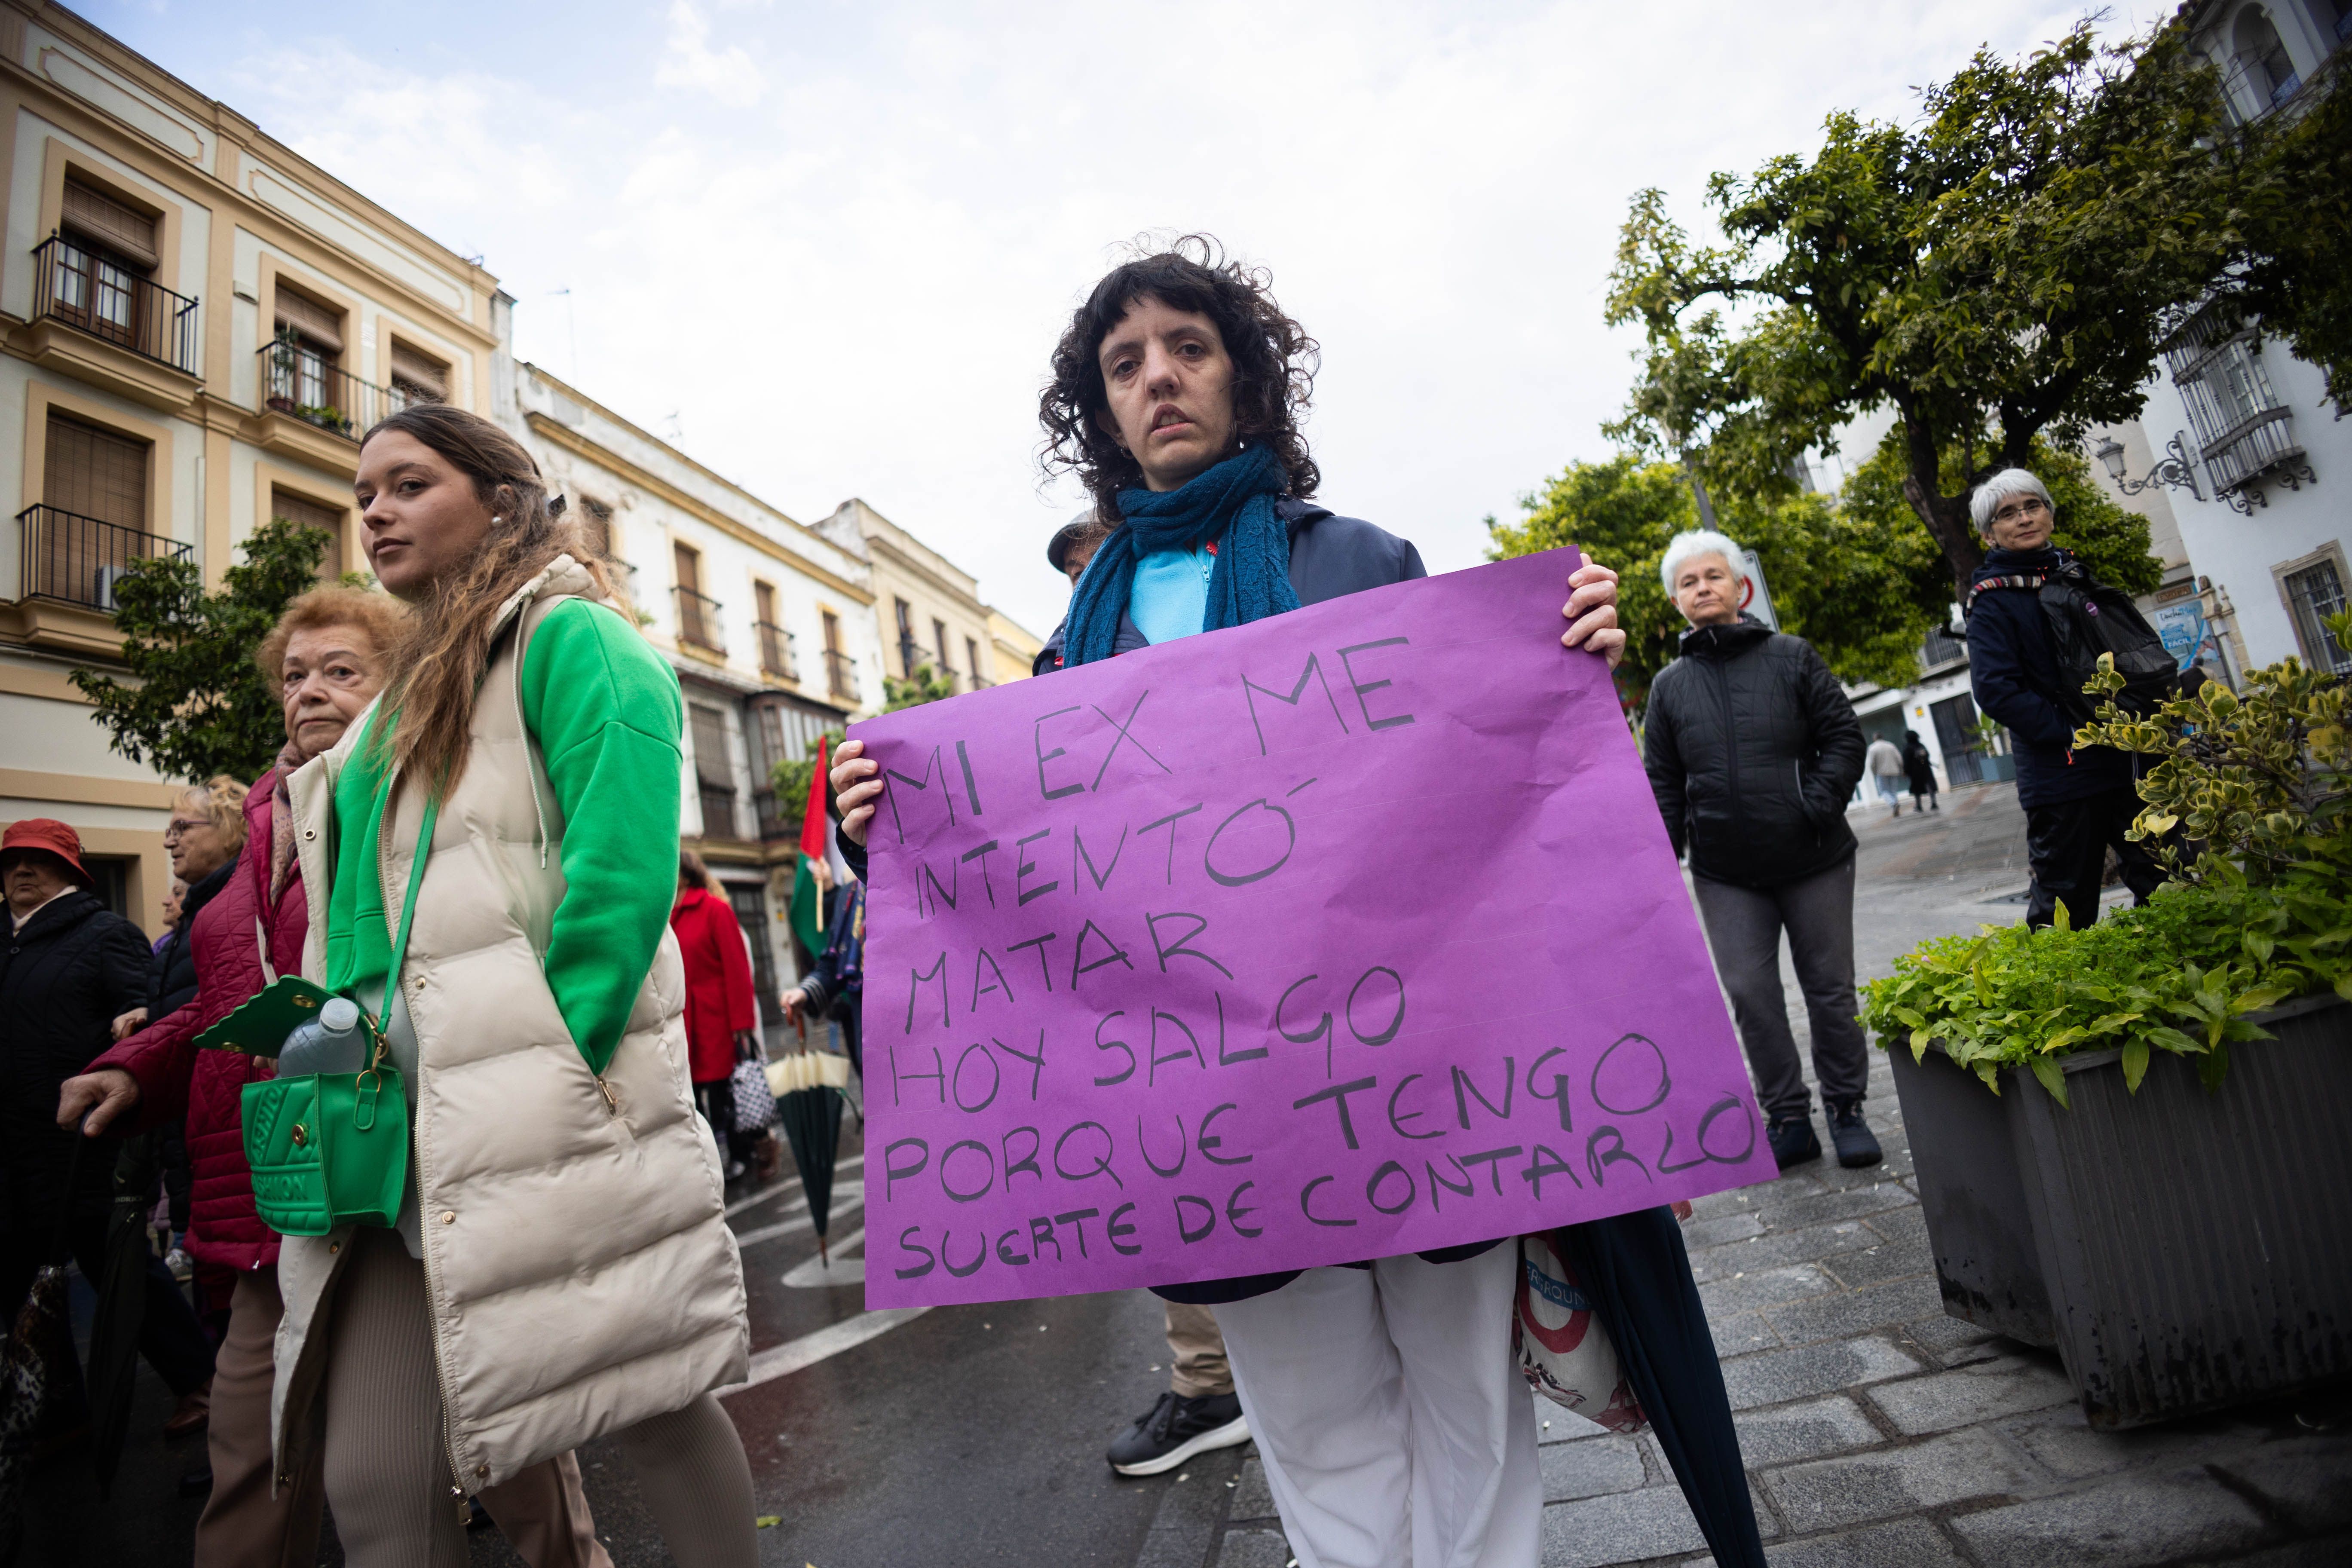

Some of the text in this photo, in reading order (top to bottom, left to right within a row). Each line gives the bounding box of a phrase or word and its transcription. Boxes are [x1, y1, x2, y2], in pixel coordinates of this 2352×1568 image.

[884, 637, 1415, 844] MI EX ME
[916, 778, 1317, 919] INTENTÓ
[890, 966, 1405, 1112] HOY SALGO
[905, 912, 1234, 1034] MATAR
[885, 1033, 1671, 1203] PORQUE TENGO
[895, 1090, 1755, 1280] SUERTE DE CONTARLO
